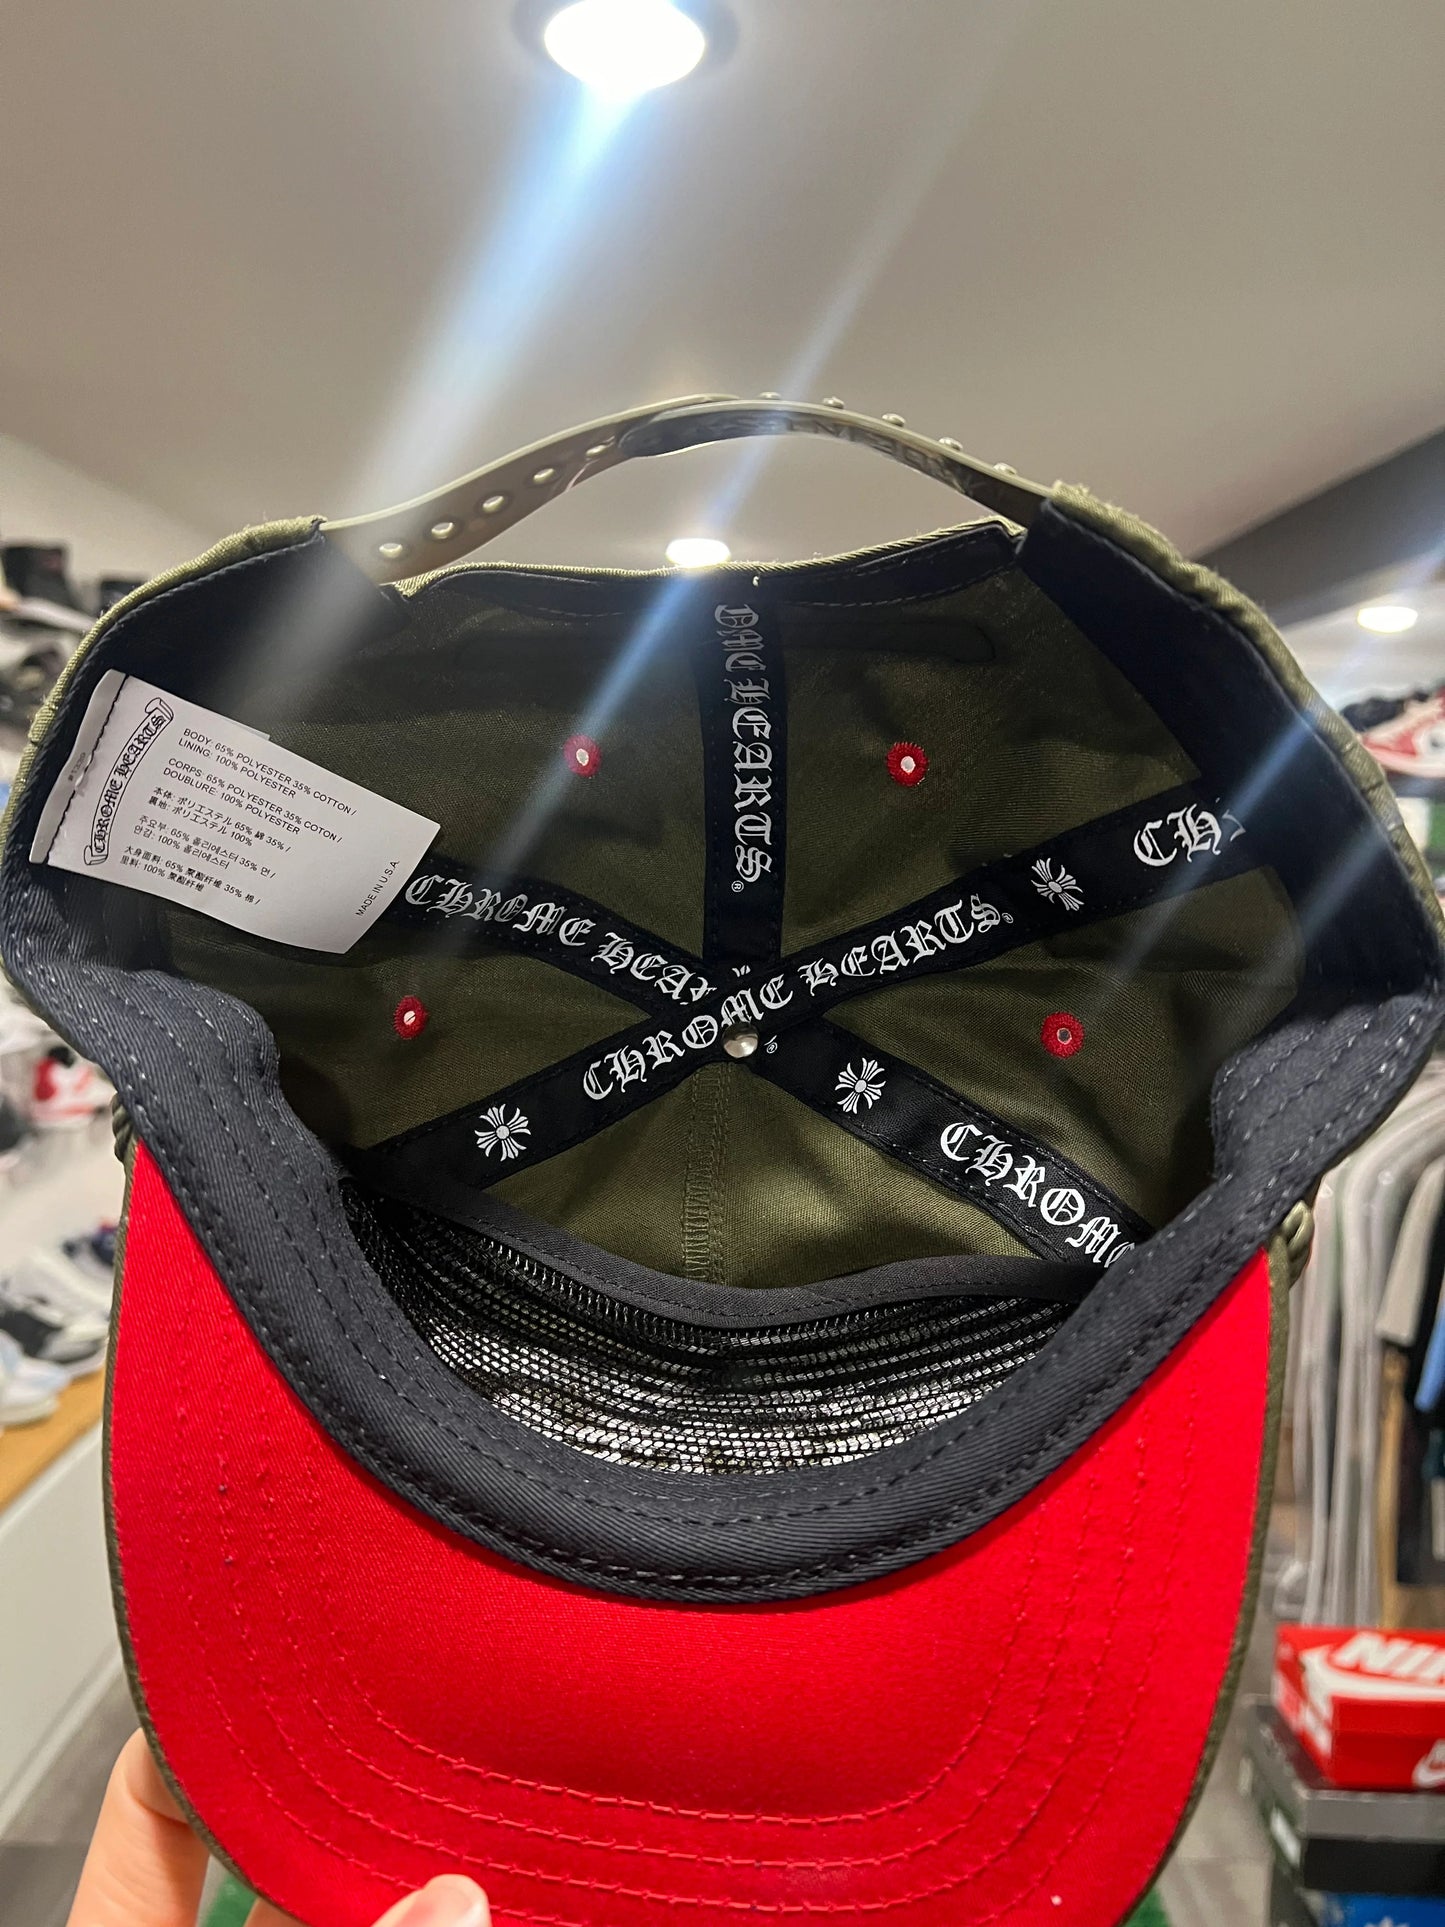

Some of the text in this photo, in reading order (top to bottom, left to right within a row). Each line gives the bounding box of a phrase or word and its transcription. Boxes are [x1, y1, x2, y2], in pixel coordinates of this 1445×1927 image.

[214, 743, 234, 757] 65%
[236, 752, 292, 784] POLYESTER
[293, 780, 312, 795] 35%
[313, 791, 352, 815] COTTON
[215, 754, 239, 771] 100%
[240, 767, 297, 798] POLYESTER
[172, 805, 227, 835] ポリエステル
[230, 831, 253, 846] 100%
[177, 796, 232, 826] ポリエステル
[234, 821, 253, 835] 65%
[266, 836, 285, 851] 35%
[206, 773, 225, 788] 65%
[227, 783, 283, 815] POLYESTER
[283, 810, 302, 825] 35%
[303, 820, 338, 842] COTON
[220, 792, 243, 808] 100%
[245, 803, 301, 835] POLYESTER
[157, 834, 181, 850] 100%
[170, 828, 190, 842] 65%
[239, 857, 258, 872] 35%
[1133, 797, 1246, 867] CH
[143, 863, 166, 877] 100%
[165, 859, 184, 873] 65%
[223, 884, 243, 898] 35%
[355, 893, 377, 916] MADE
[372, 884, 383, 893] IN
[404, 873, 597, 947] CHROME
[583, 973, 794, 1100] CHROME
